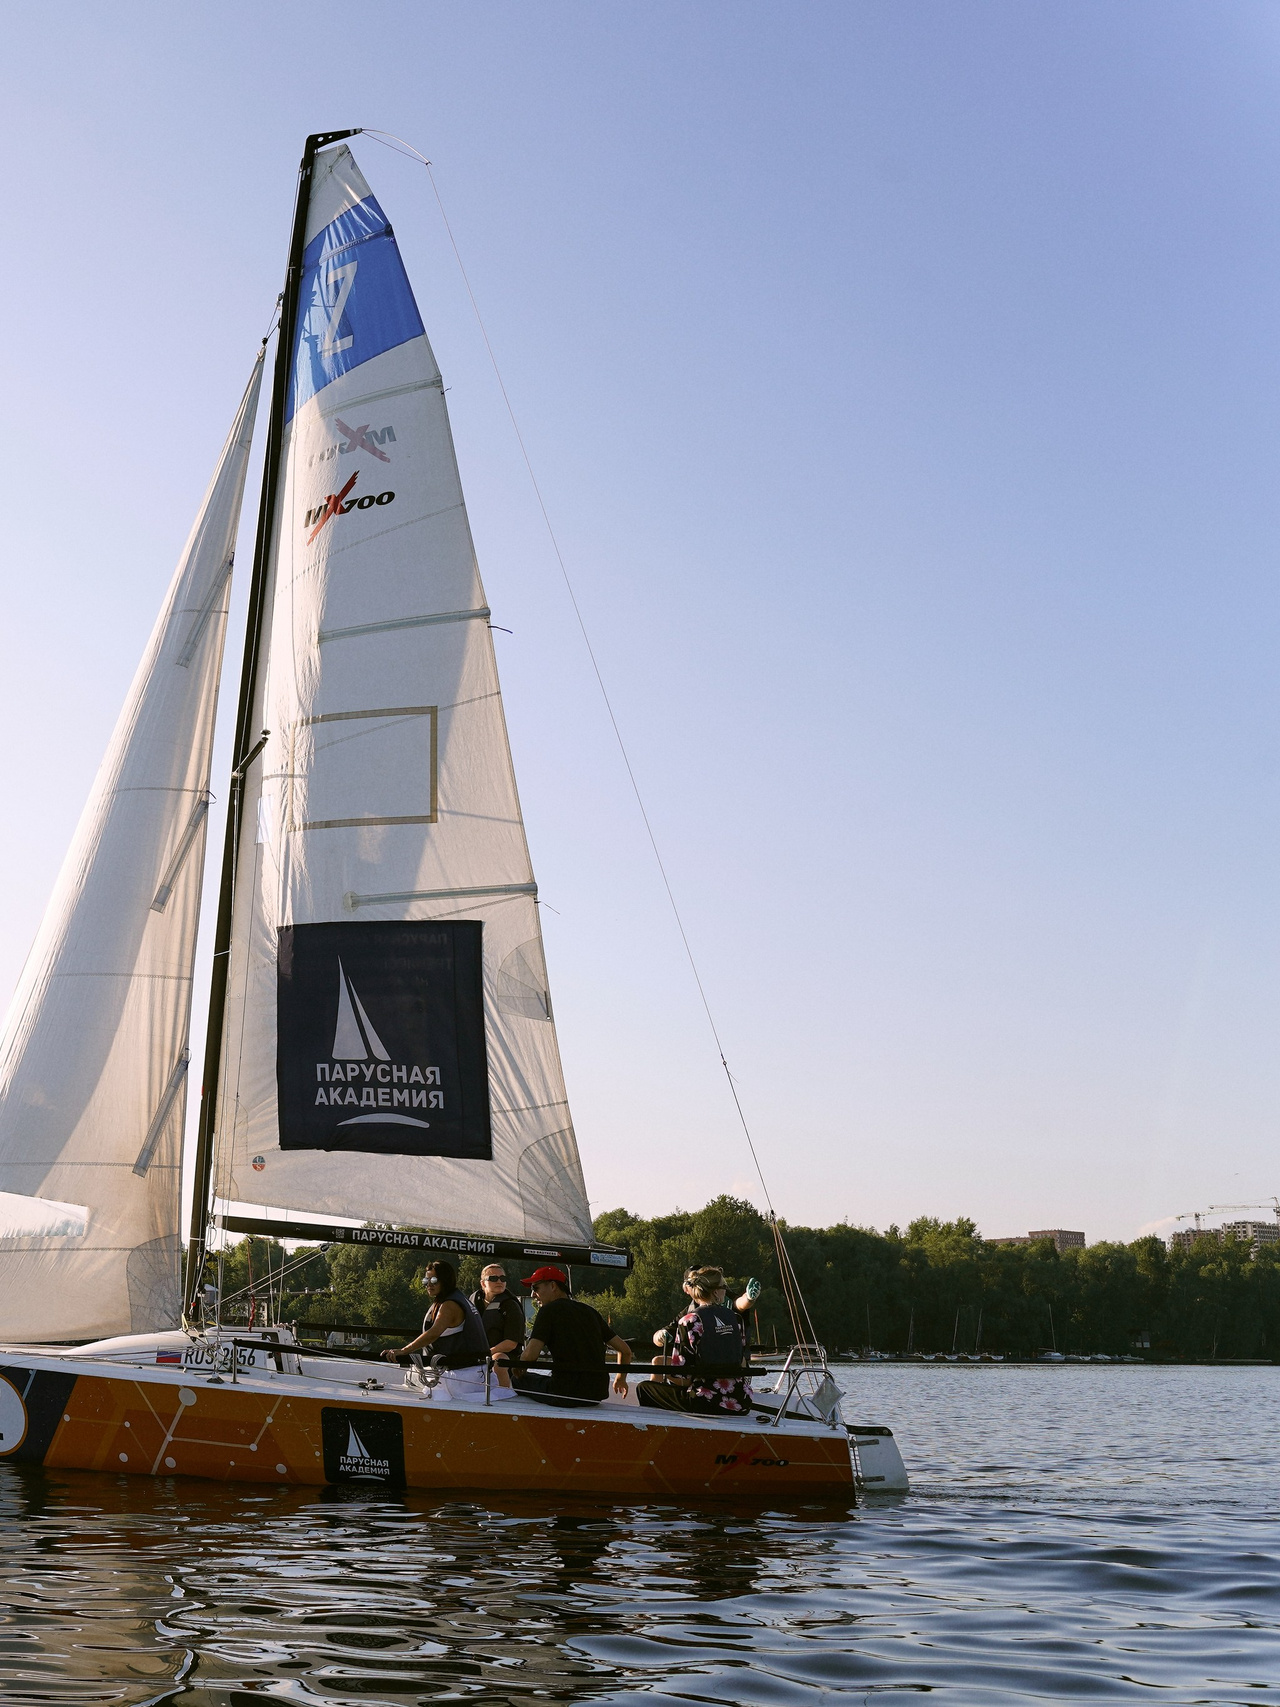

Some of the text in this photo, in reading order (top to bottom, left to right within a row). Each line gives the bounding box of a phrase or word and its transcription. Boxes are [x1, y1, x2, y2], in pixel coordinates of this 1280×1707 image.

[304, 469, 395, 547] MX700
[316, 1063, 441, 1086] ПАРУСНАЯ
[314, 1087, 444, 1109] АКАДЕМИЯ
[352, 1229, 495, 1254] ПАРУСНАЯ АКАДЕМИЯ
[184, 1346, 214, 1365] RUS
[339, 1464, 390, 1475] АКАДЕМИЯ
[340, 1456, 389, 1467] ПАРУСНАЯ
[714, 1442, 790, 1475] MX700
